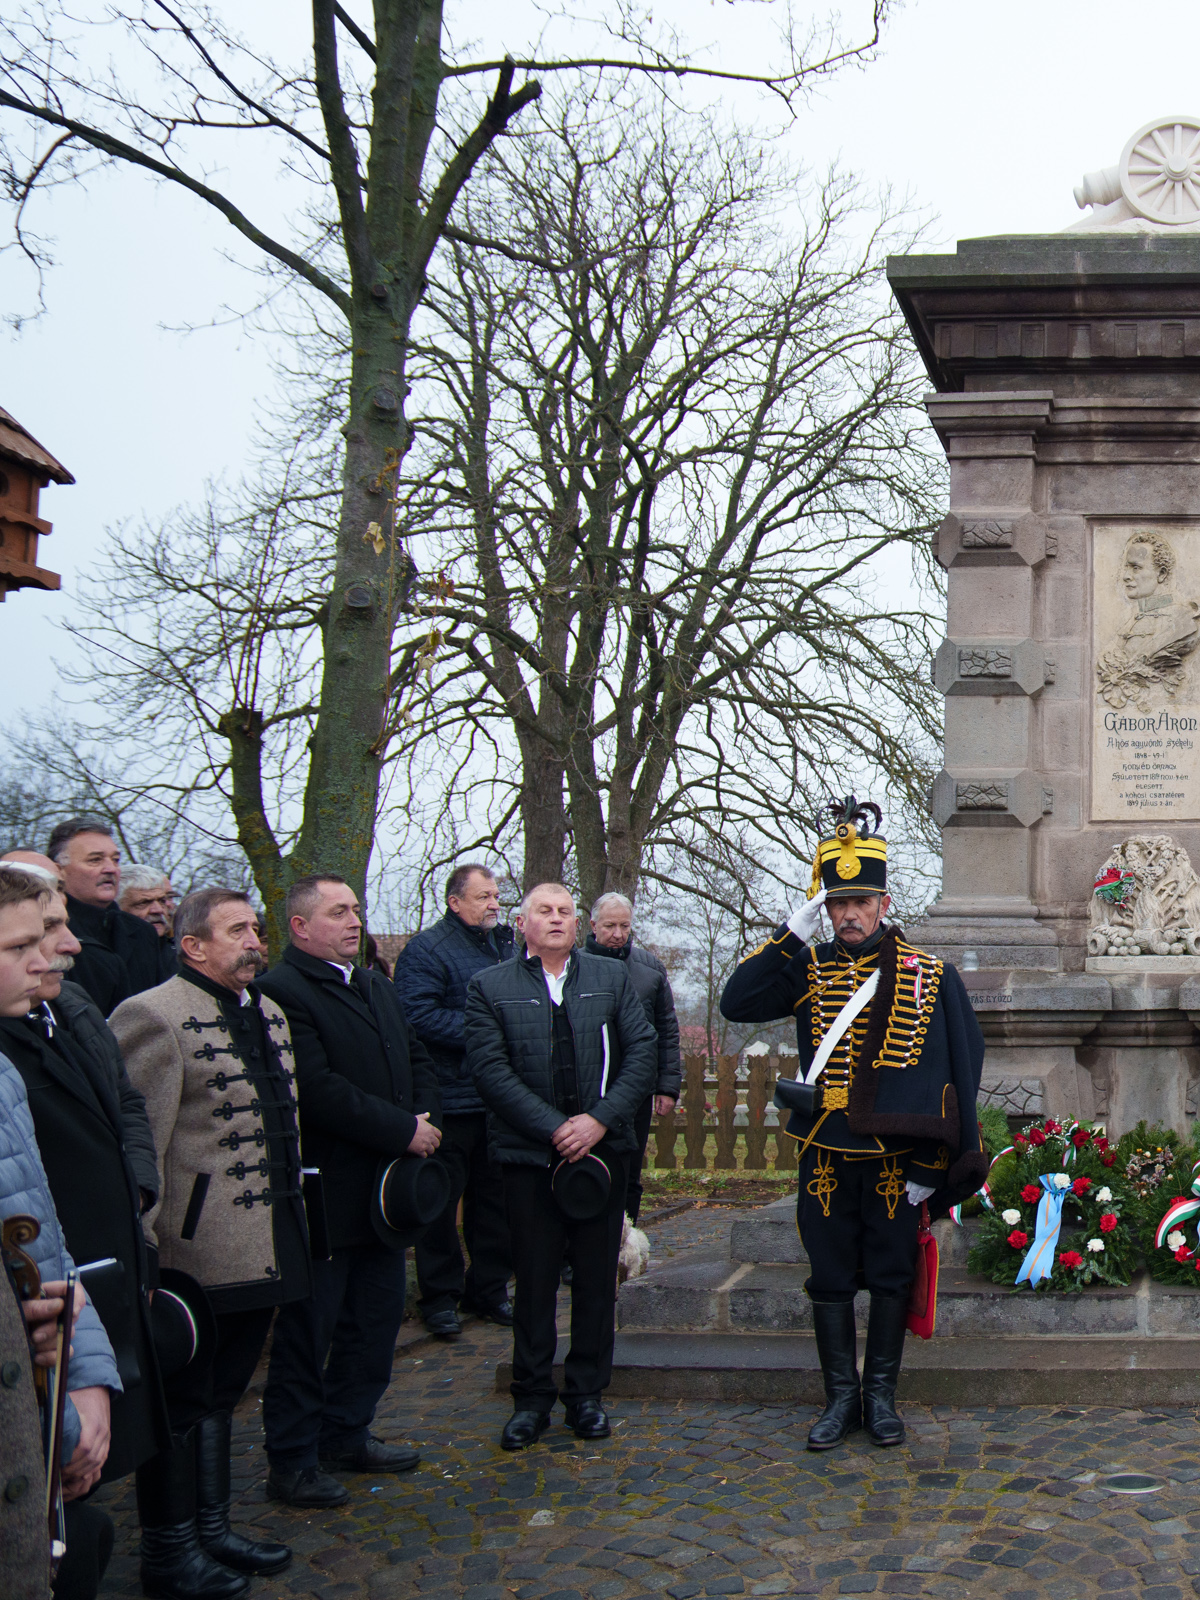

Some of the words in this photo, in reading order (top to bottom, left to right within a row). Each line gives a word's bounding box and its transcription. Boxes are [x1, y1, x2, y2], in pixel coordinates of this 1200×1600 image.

[1104, 712, 1158, 735] GÁBOR
[1155, 709, 1198, 735] ÁRON
[1106, 736, 1114, 748] A
